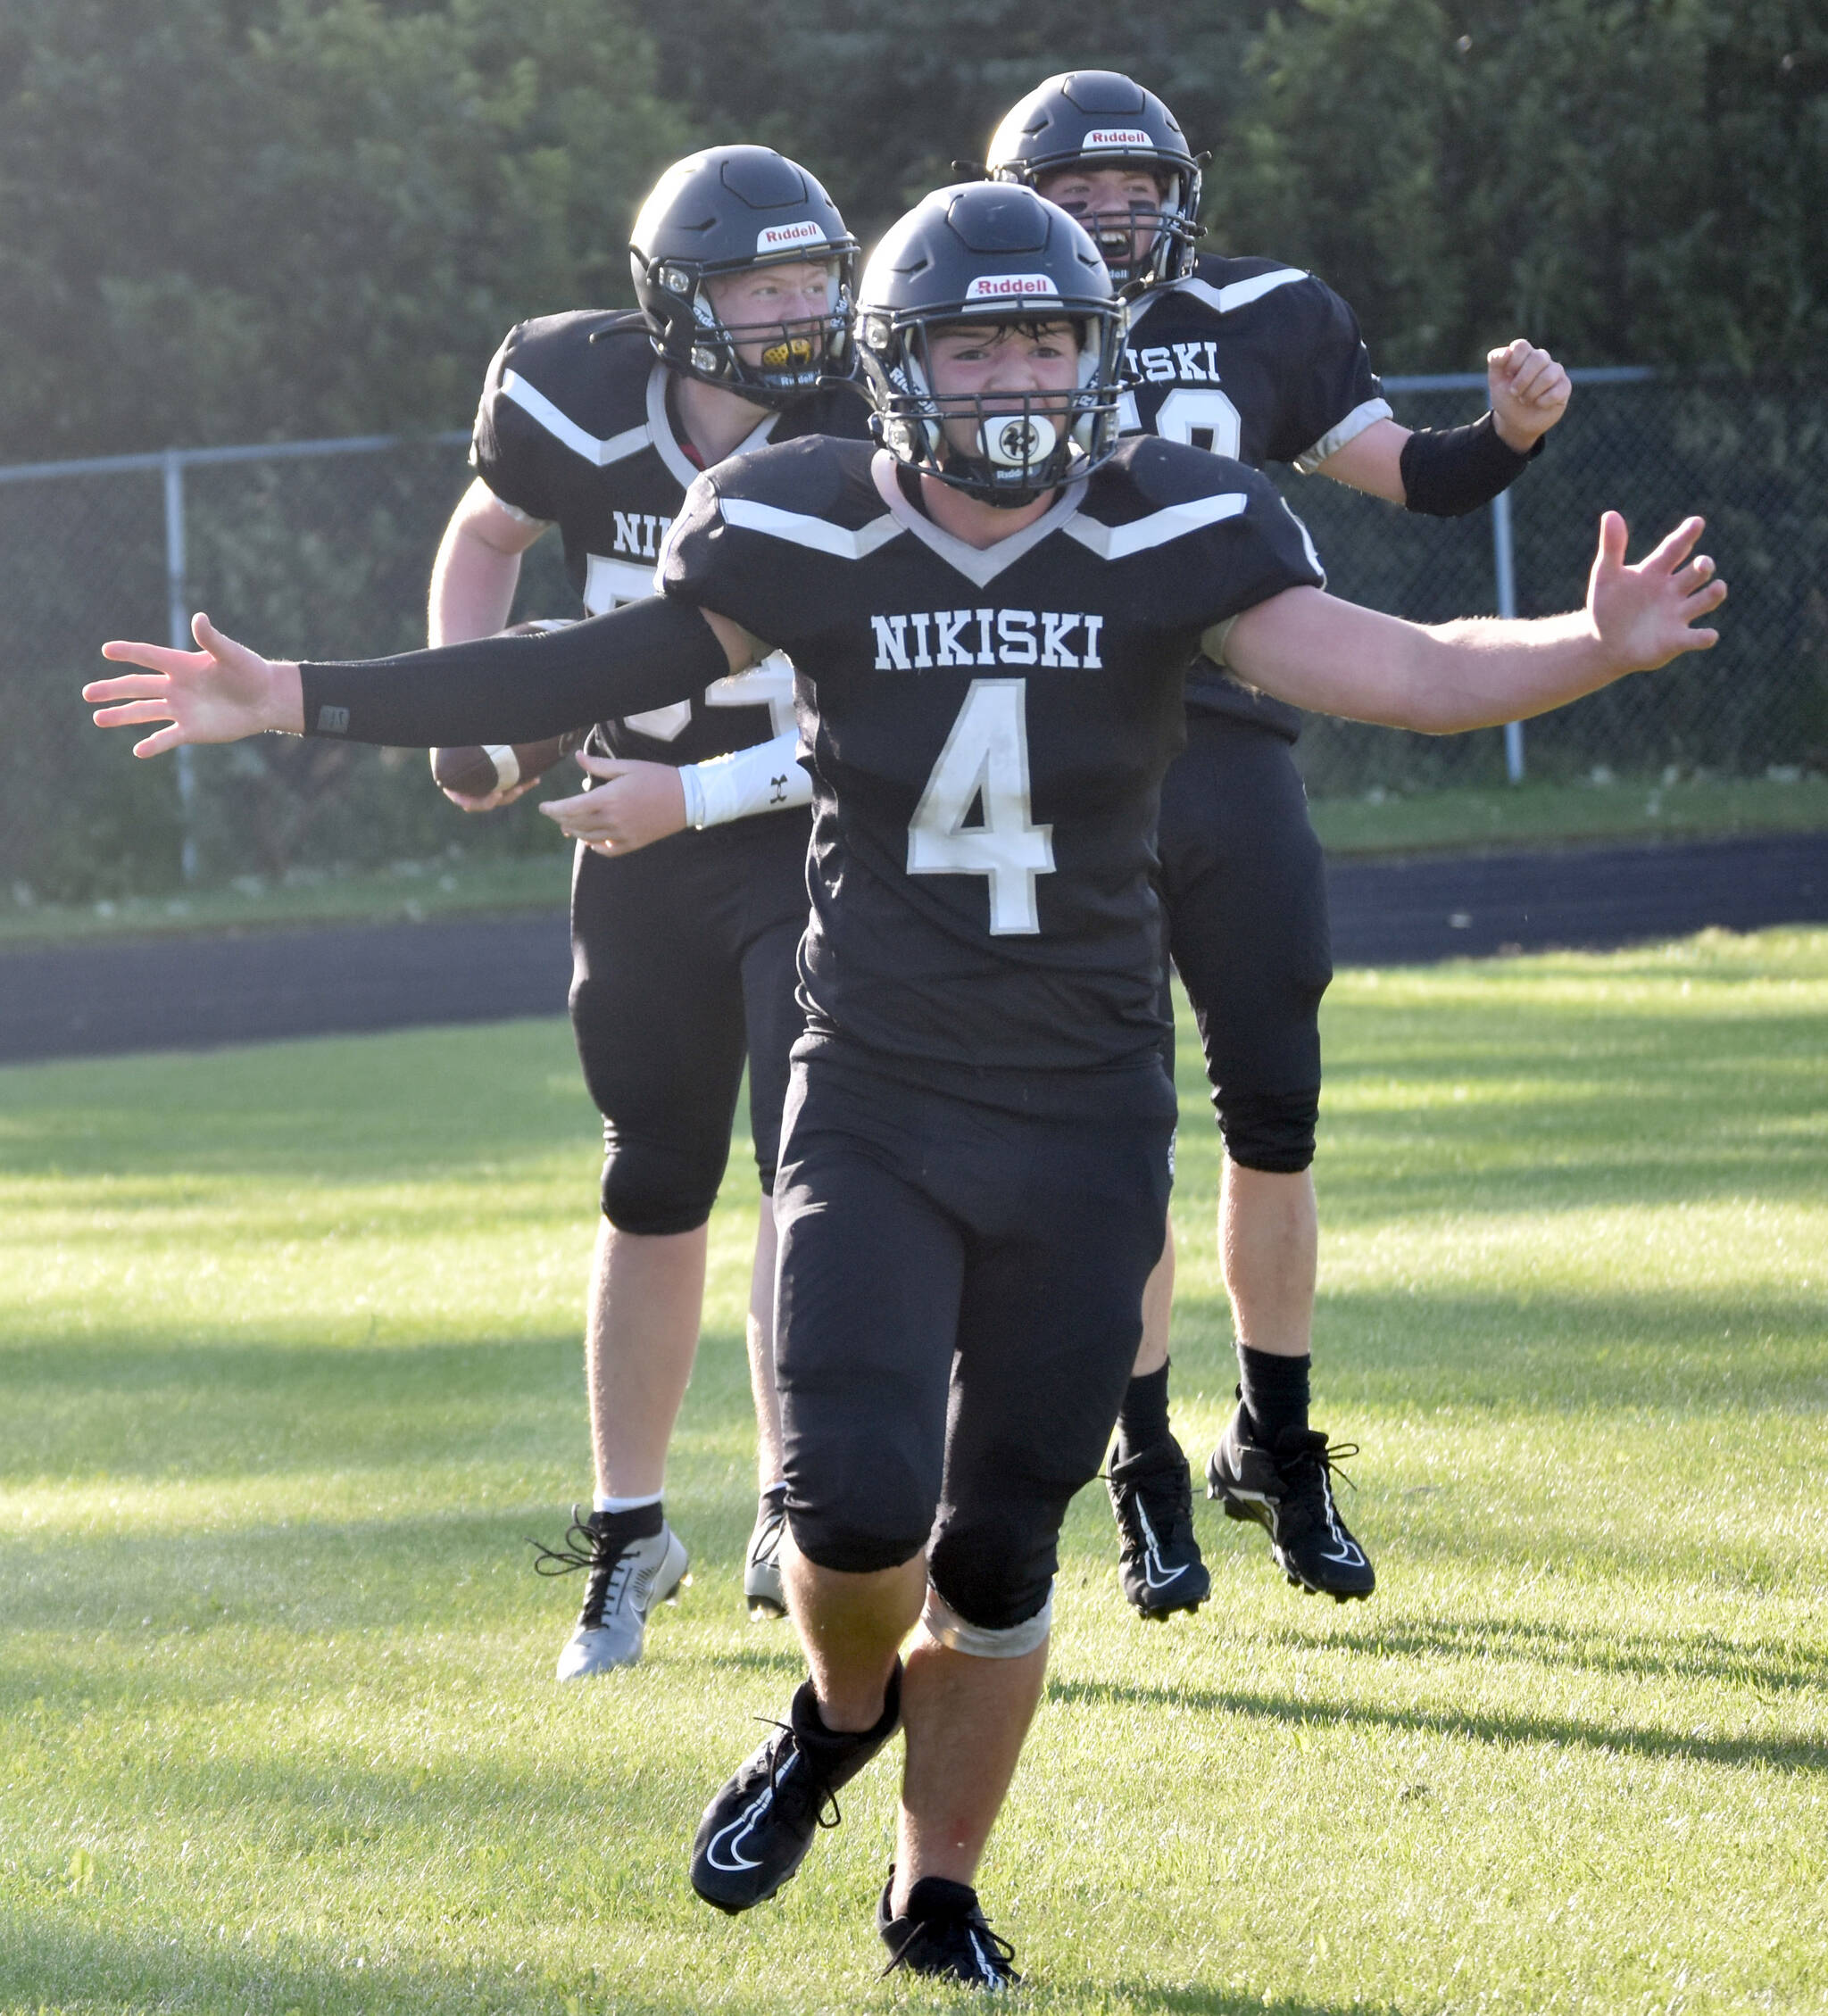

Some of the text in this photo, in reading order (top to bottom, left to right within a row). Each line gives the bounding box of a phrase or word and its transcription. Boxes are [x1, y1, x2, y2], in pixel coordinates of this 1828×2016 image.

[1093, 132, 1145, 143] Riddell
[766, 224, 817, 243] Riddell
[978, 279, 1047, 295] Riddell
[871, 609, 1103, 670] NIKISKI
[907, 677, 1057, 935] 4
